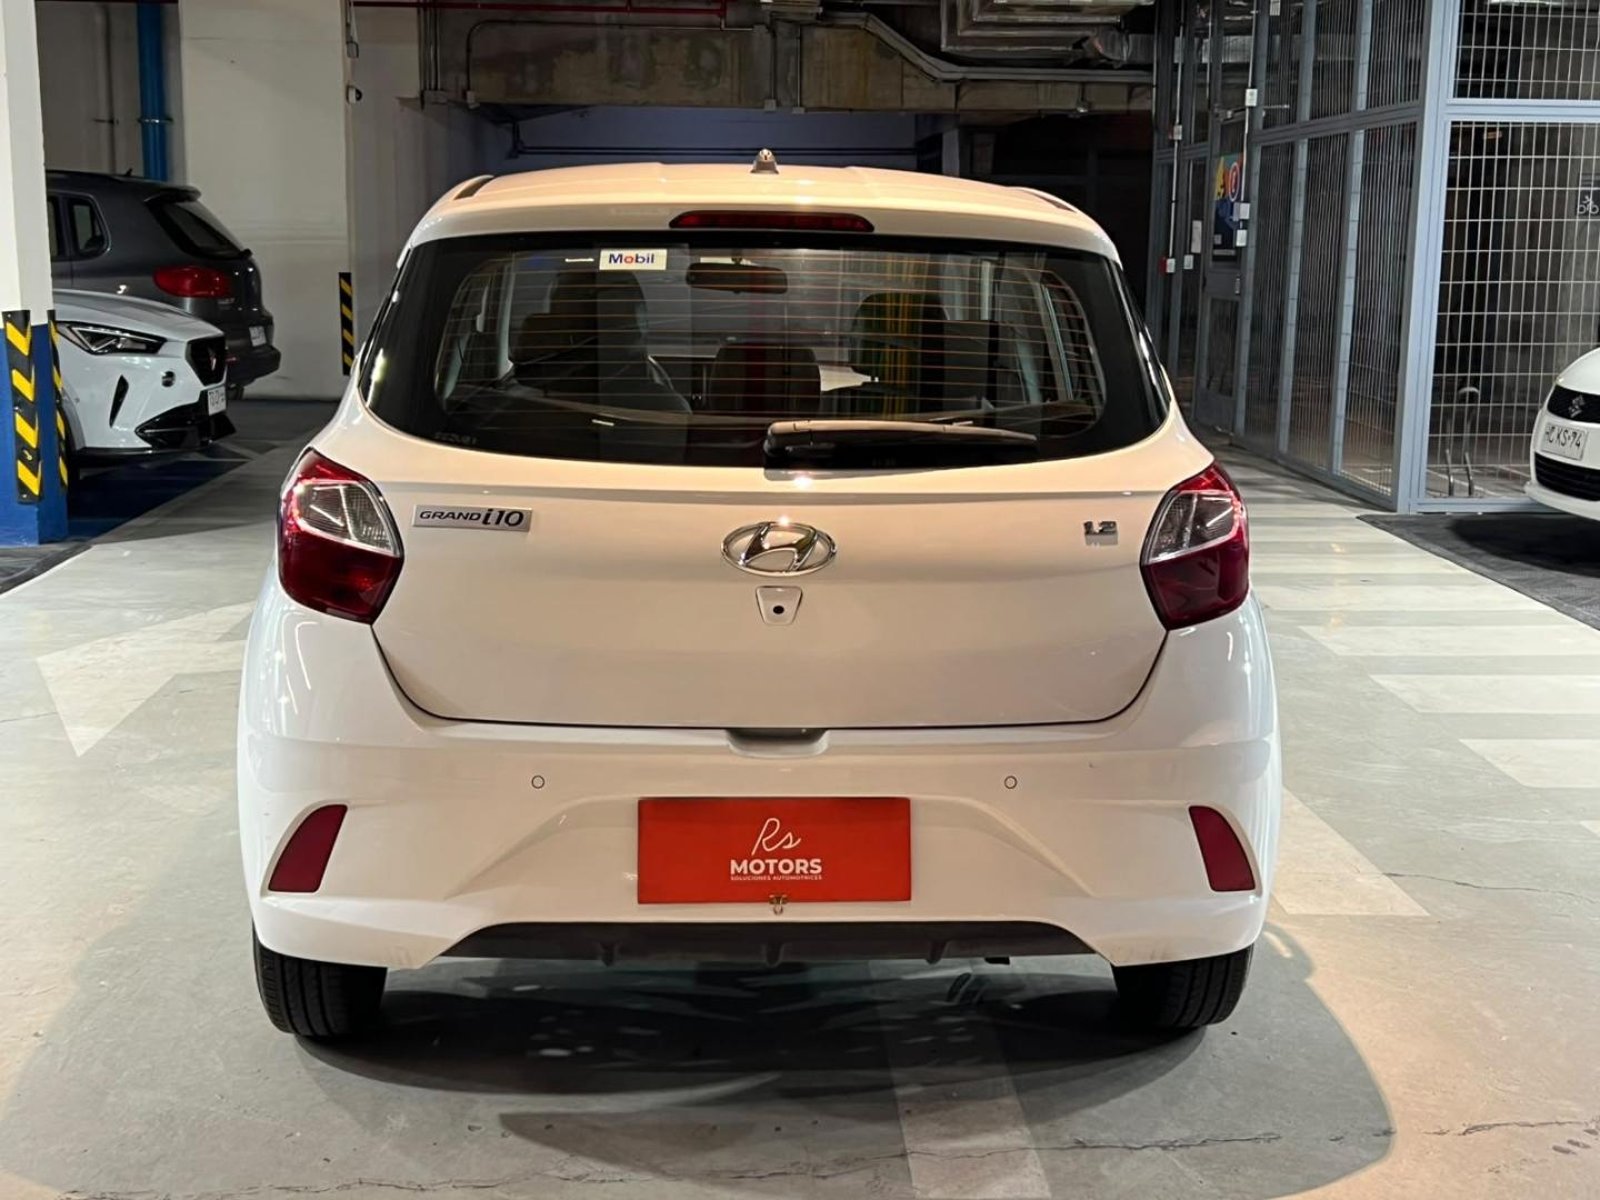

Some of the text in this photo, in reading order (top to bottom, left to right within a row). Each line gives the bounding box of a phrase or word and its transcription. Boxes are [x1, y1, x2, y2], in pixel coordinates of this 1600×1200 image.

[608, 253, 655, 264] Mobil
[419, 508, 525, 527] GRAND i10
[1084, 521, 1117, 537] 1.2
[751, 817, 801, 856] Rs
[730, 858, 822, 875] MOTORS
